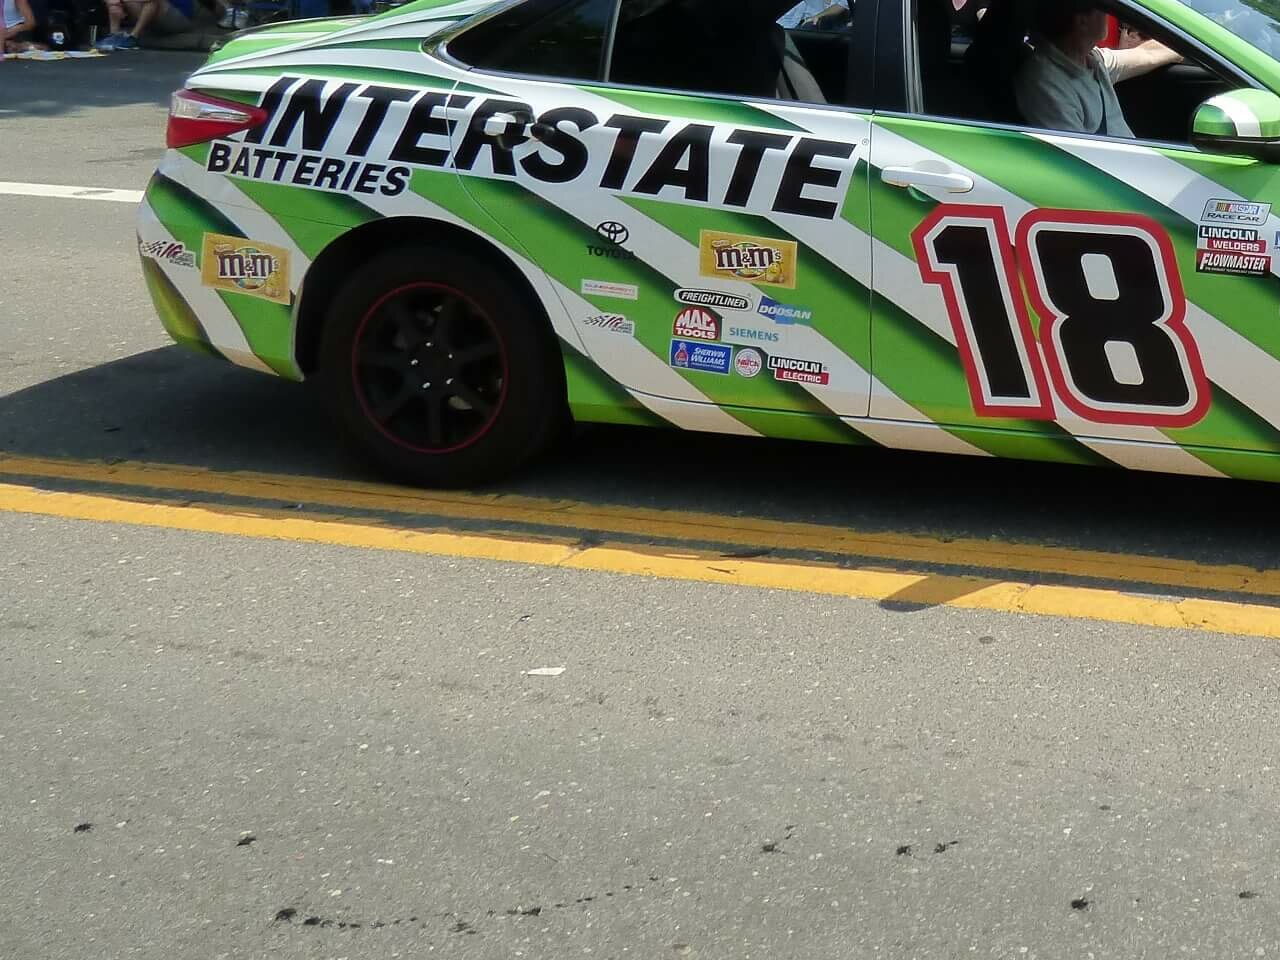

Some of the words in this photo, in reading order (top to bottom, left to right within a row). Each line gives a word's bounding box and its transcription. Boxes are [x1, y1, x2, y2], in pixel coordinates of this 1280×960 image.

[243, 76, 857, 220] INTERSTATE
[207, 143, 411, 197] BATTERIES
[1201, 227, 1255, 241] LINCOLN
[1212, 240, 1260, 252] WELDERS
[1200, 252, 1266, 271] FLOWMASTER
[681, 291, 746, 308] FREIGHTLINER
[758, 304, 812, 320] DOOSAN
[921, 214, 1200, 417] 18
[676, 309, 716, 332] MAC
[676, 327, 716, 339] TOOLS
[729, 326, 780, 342] SIEMENS
[690, 354, 726, 367] WILLIAMS
[693, 347, 727, 359] SHERWIN
[771, 356, 821, 374] LINCOLN
[782, 370, 823, 384] ELECTRIC
